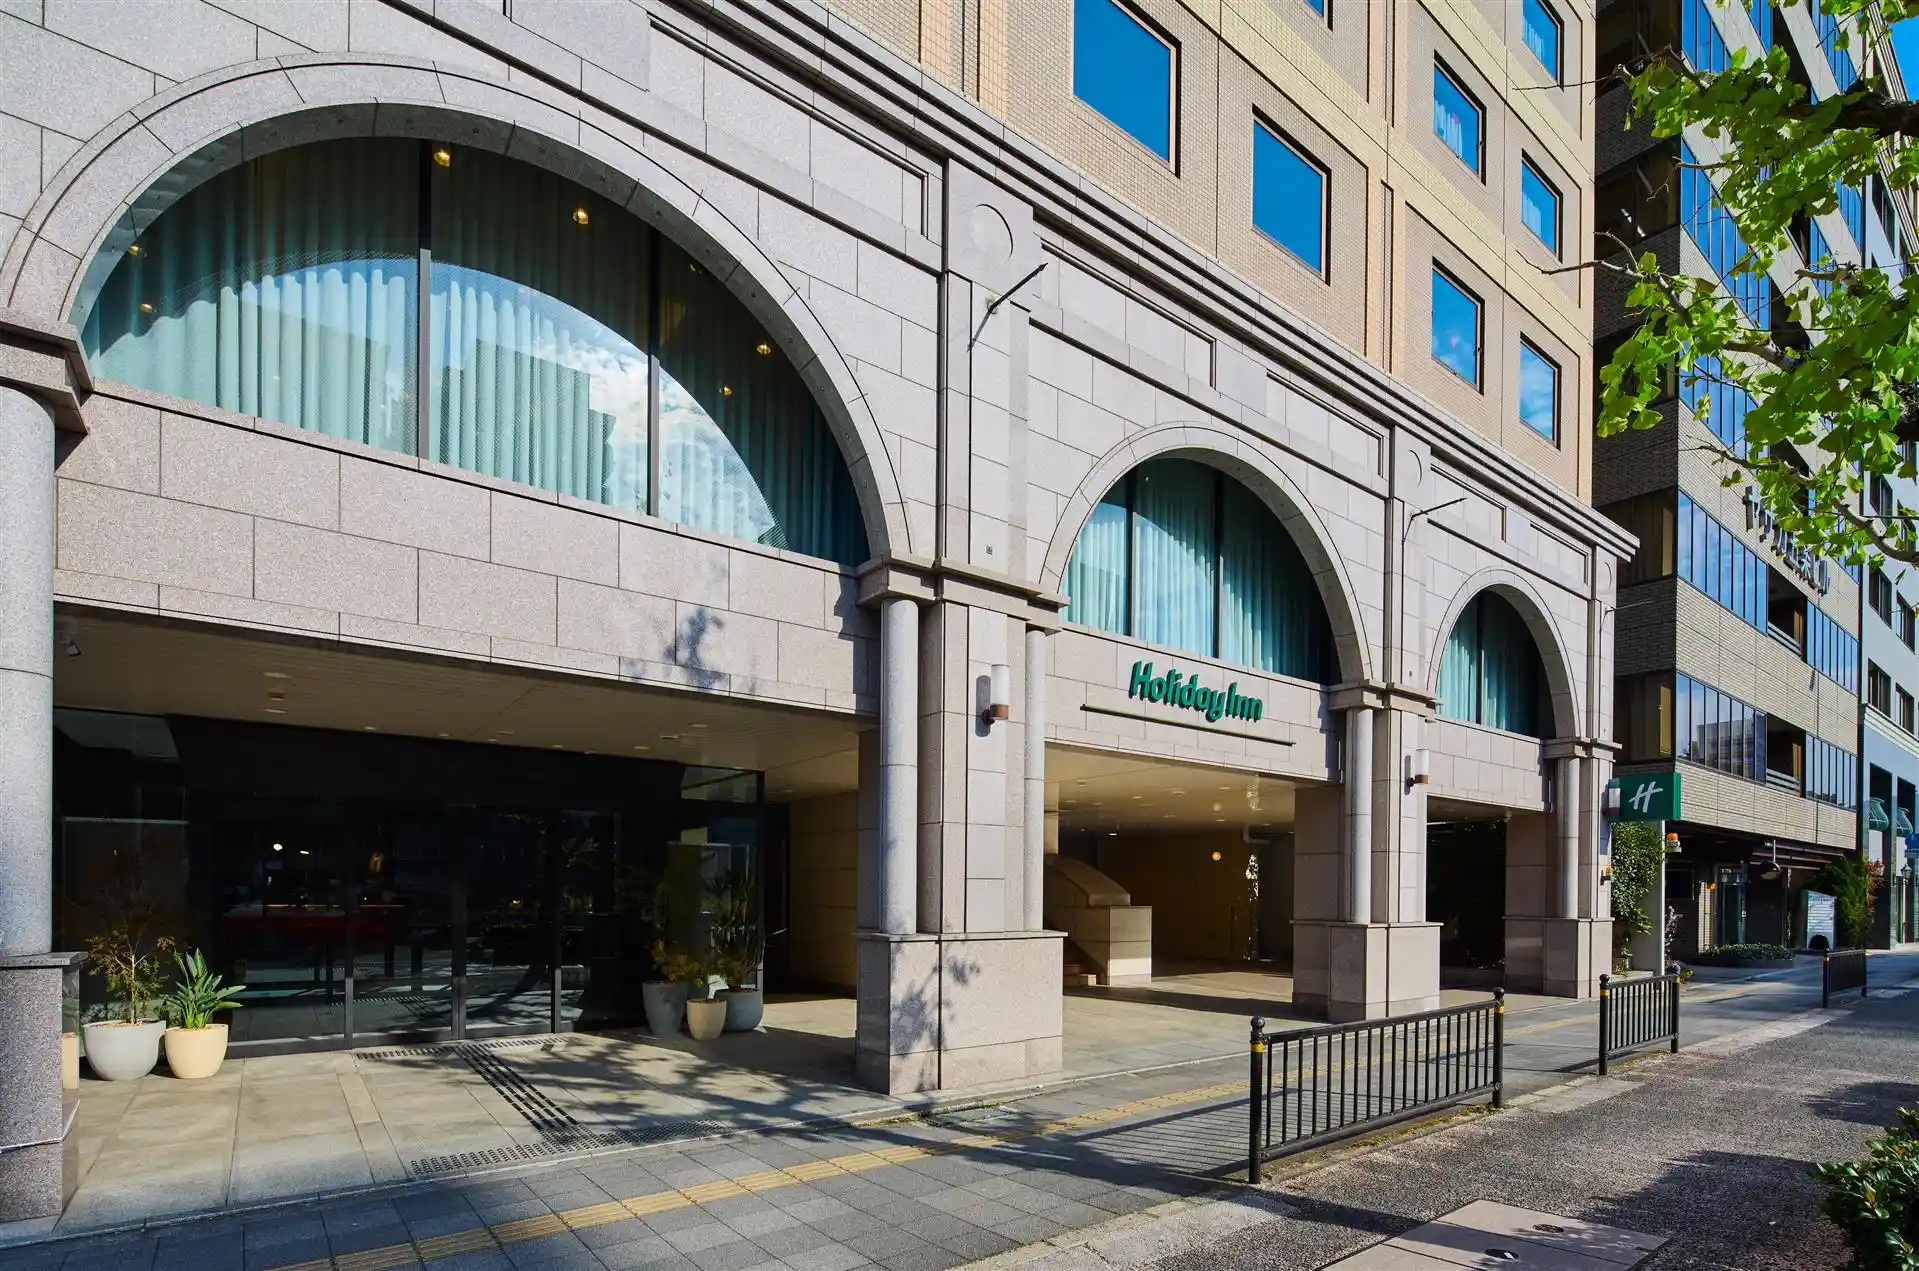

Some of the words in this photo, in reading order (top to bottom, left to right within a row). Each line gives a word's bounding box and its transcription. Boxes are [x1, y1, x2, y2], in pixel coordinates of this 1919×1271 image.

[1129, 660, 1226, 722] Holiday
[1226, 682, 1263, 722] Inn
[1628, 781, 1664, 813] H
